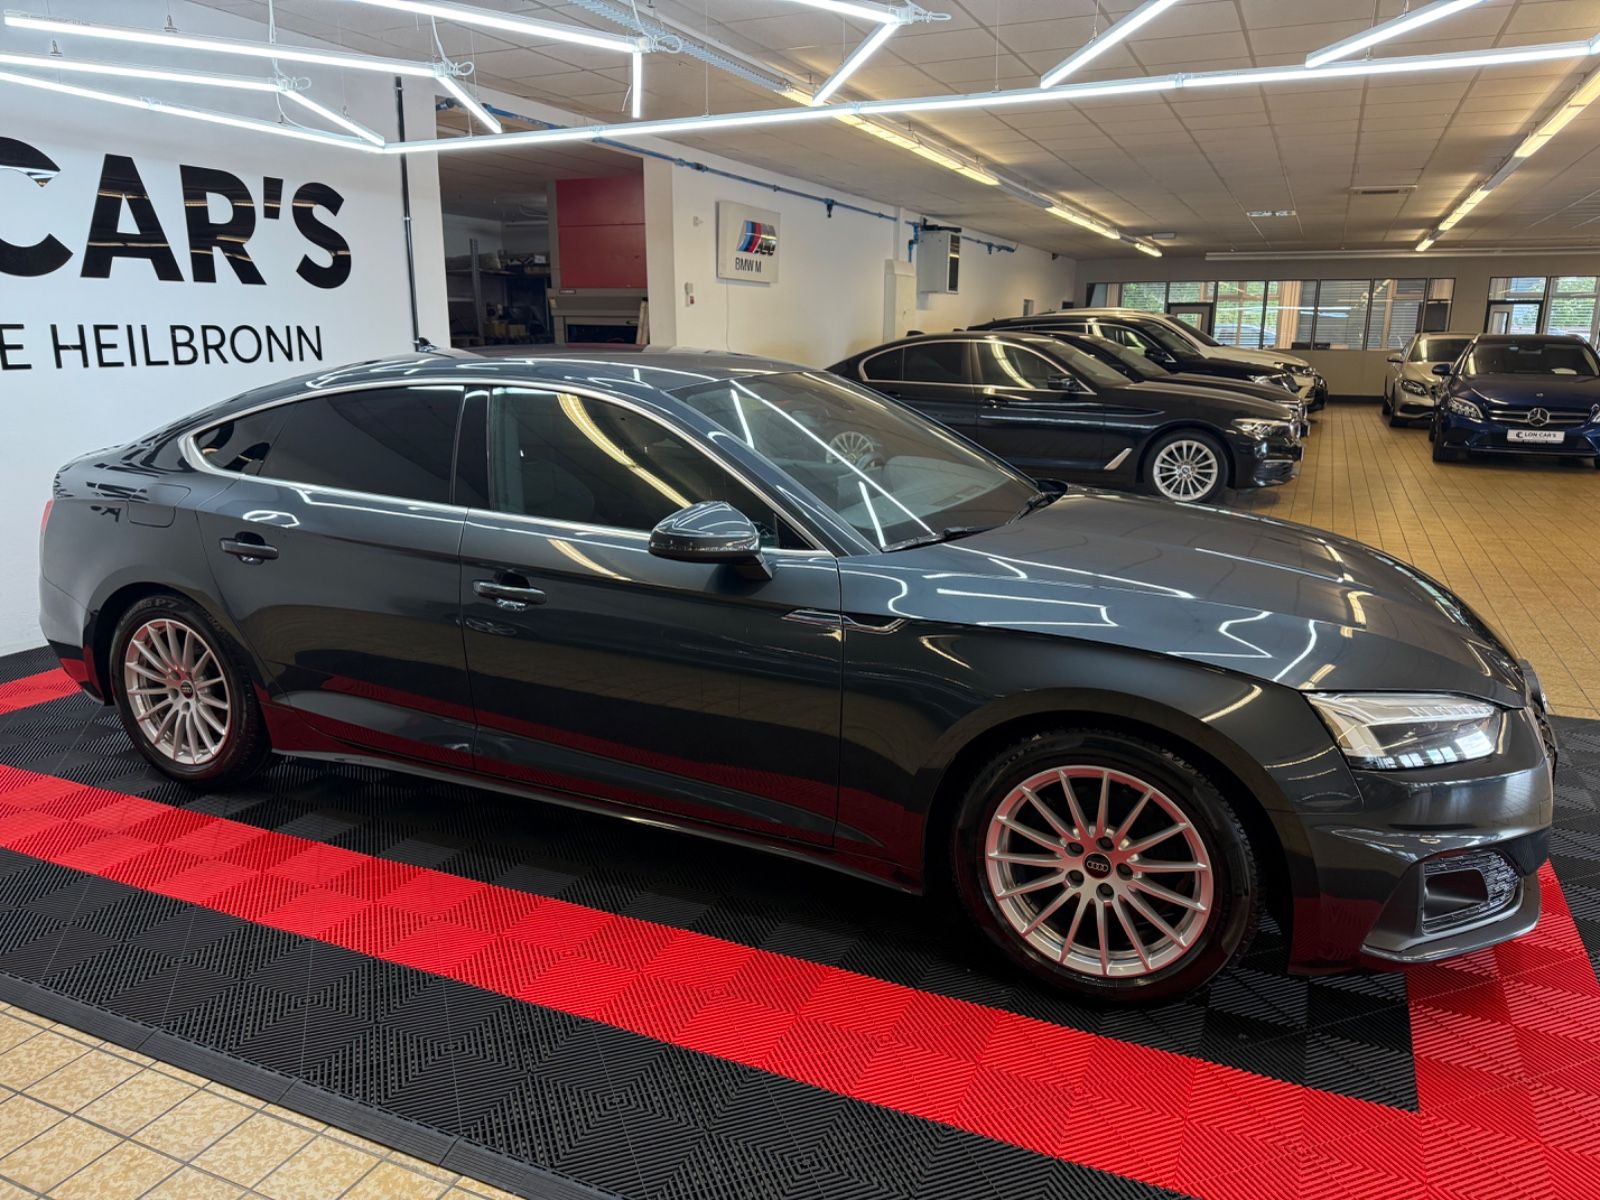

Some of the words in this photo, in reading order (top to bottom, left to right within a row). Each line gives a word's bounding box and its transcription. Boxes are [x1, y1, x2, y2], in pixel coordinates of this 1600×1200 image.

[0, 136, 351, 288] CAR'S
[735, 257, 754, 271] BMW
[755, 260, 762, 272] M
[50, 323, 324, 369] HEILBRONN
